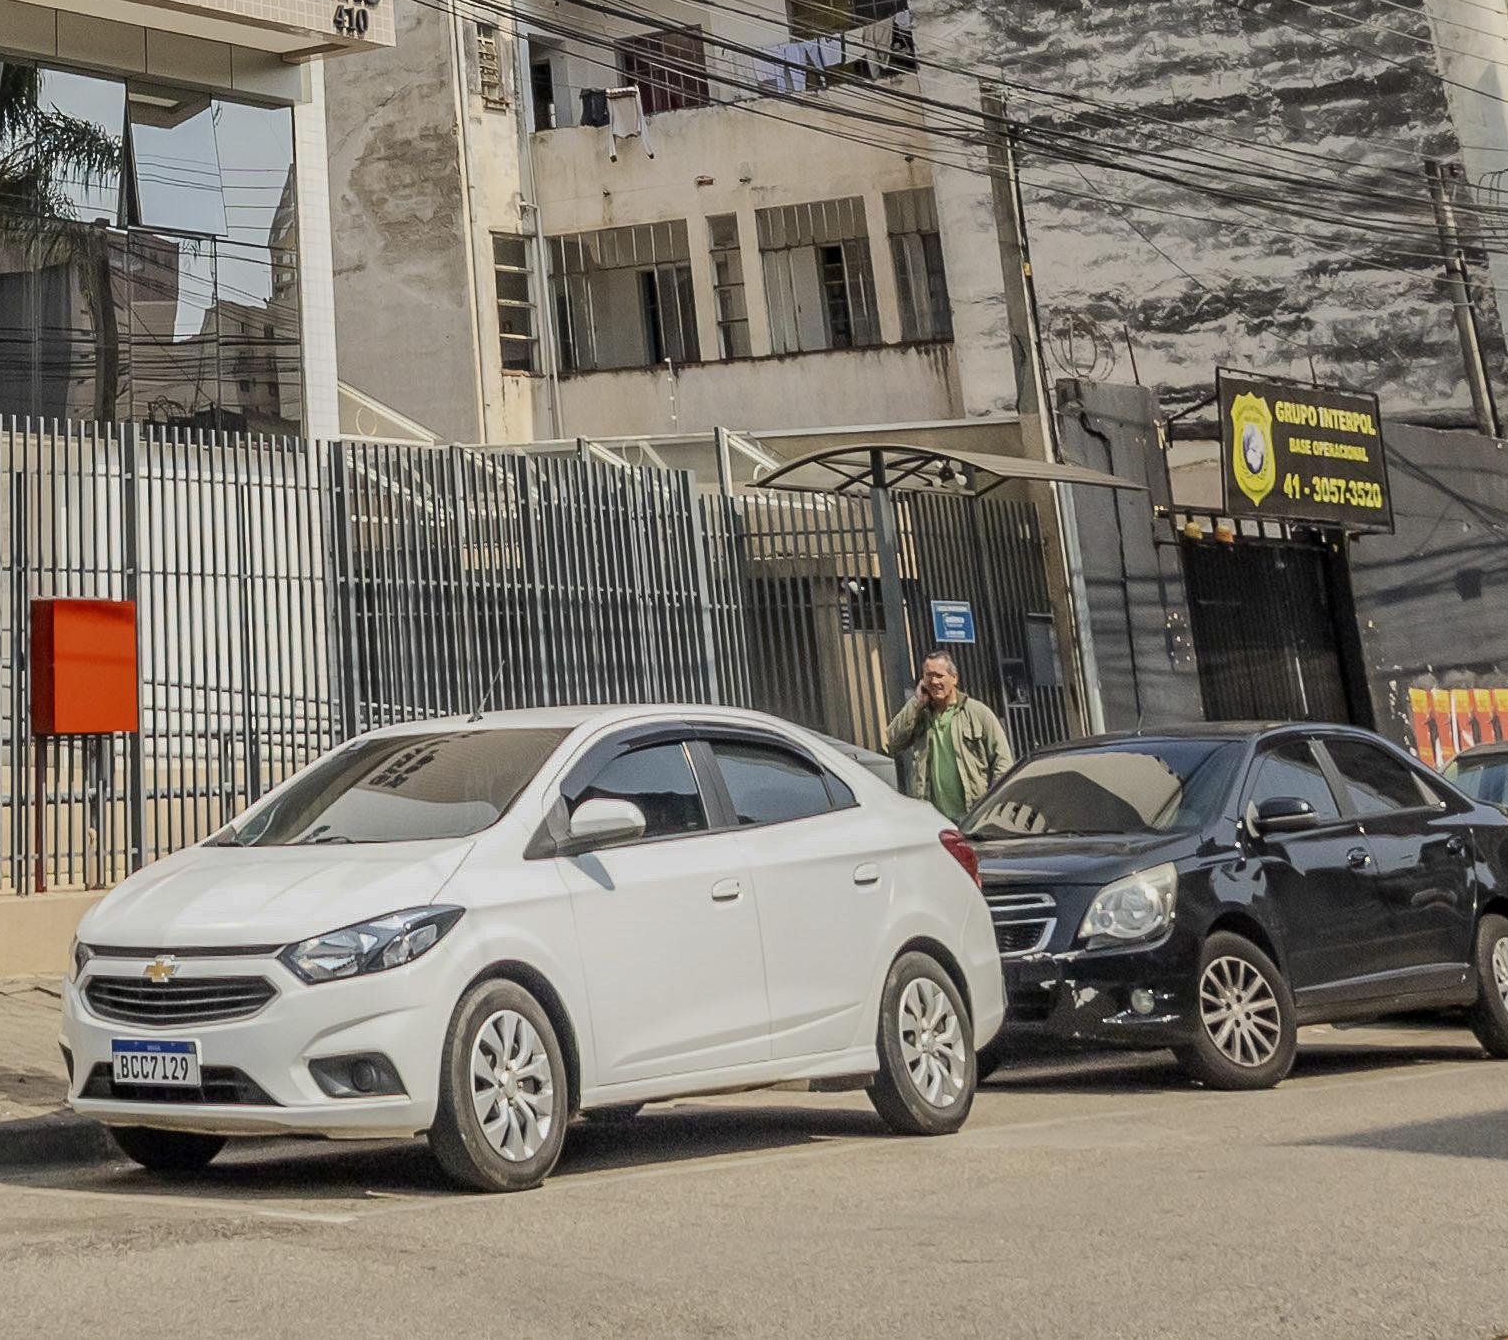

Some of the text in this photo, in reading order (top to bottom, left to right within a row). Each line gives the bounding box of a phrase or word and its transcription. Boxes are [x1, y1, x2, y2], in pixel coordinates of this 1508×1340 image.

[333, 4, 369, 35] 410
[1275, 400, 1377, 436] GRUPO INTERPOL
[1289, 437, 1369, 463] BASE OPERACIONAL
[1283, 473, 1301, 500] 41
[1312, 475, 1383, 509] 3057-3520
[120, 1055, 189, 1081] BCC7129
